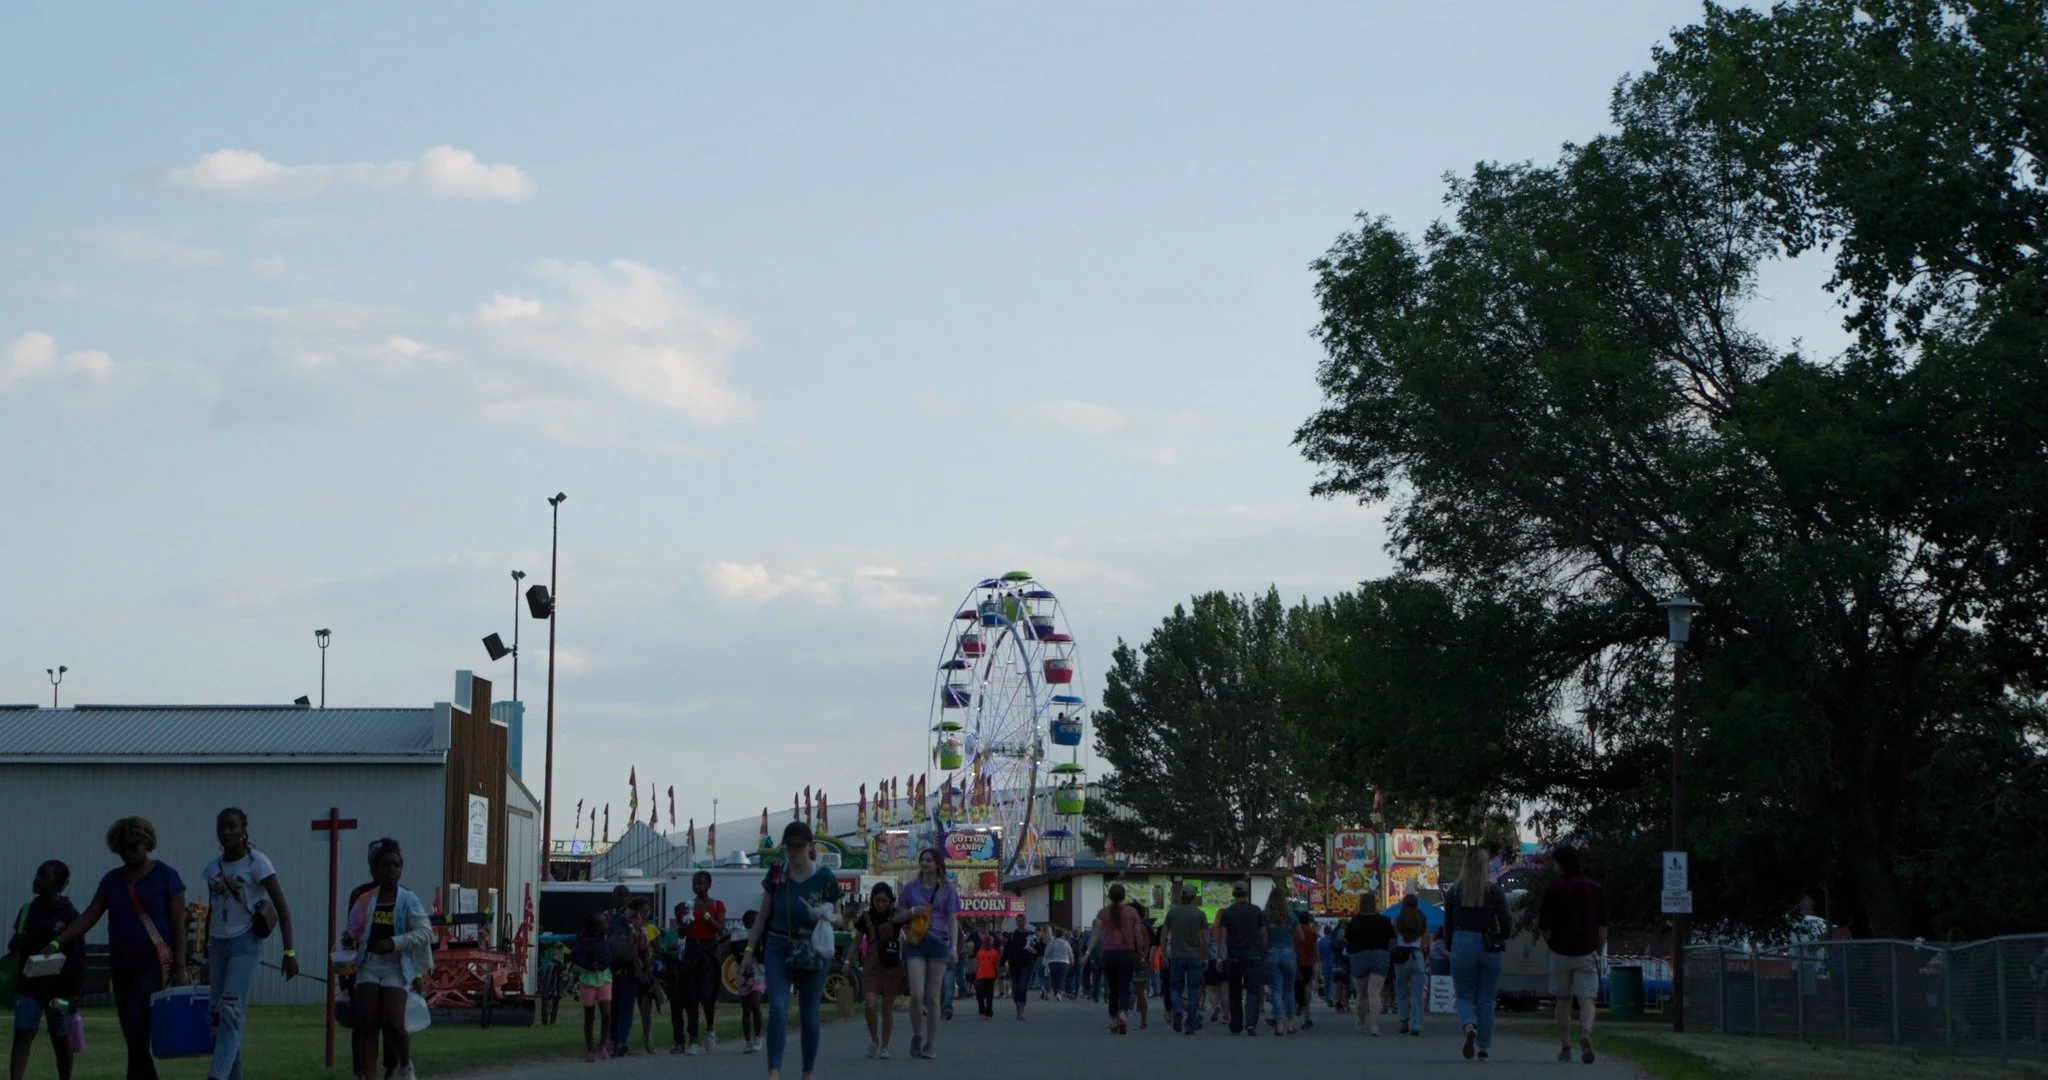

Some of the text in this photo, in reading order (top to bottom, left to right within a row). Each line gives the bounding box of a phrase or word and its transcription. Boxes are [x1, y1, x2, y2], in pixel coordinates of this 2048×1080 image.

[952, 834, 986, 844] COTTON
[955, 843, 984, 852] CANDY
[959, 898, 1006, 911] OPCORN
